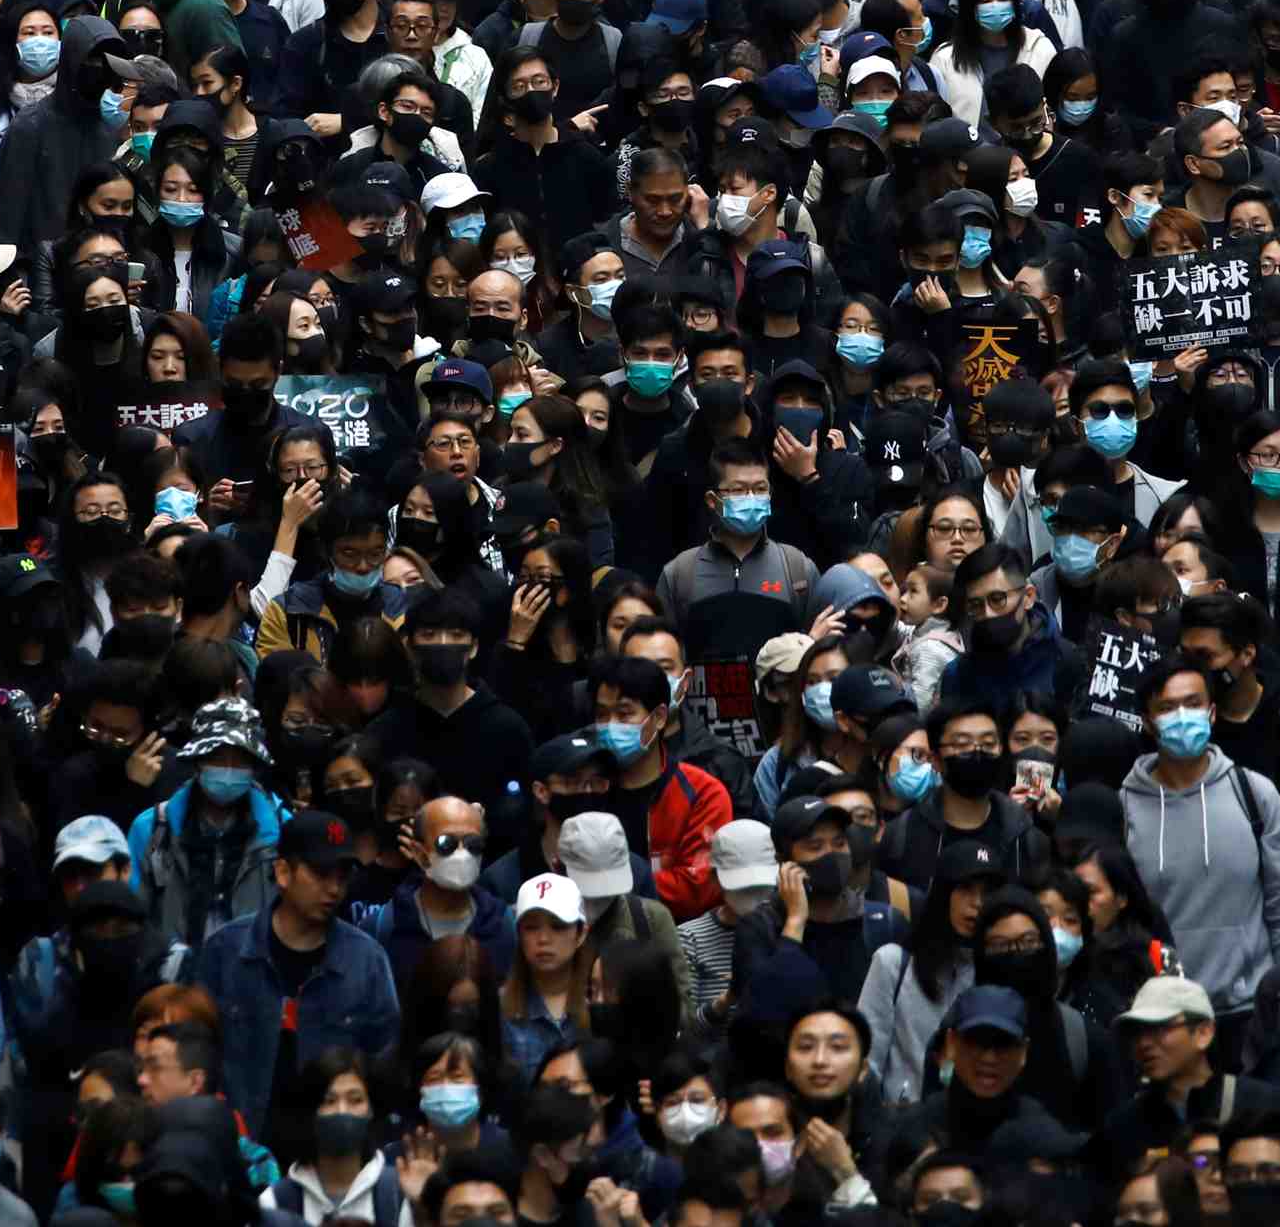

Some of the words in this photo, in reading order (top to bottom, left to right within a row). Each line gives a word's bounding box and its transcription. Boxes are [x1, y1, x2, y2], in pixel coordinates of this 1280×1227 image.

[1128, 260, 1252, 303] 五大訴求
[1133, 293, 1253, 336] 缺一不可
[884, 440, 901, 461] NY
[536, 880, 552, 900] P
